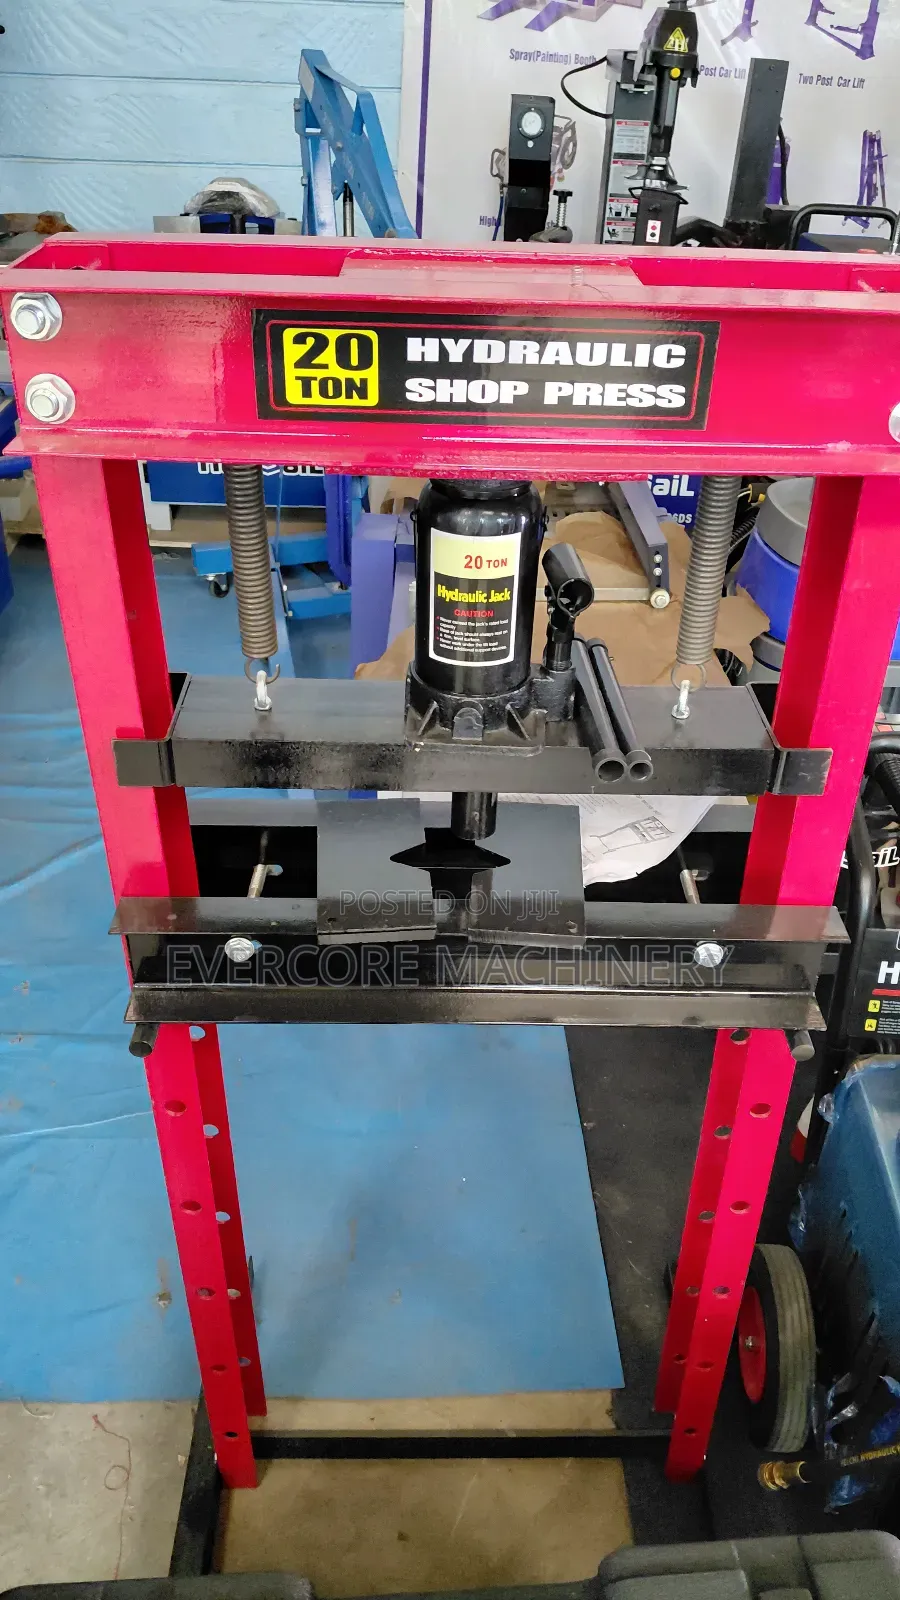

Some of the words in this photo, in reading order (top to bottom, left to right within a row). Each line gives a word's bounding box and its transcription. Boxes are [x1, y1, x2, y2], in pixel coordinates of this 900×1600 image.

[509, 48, 572, 65] Spray(Painting)
[574, 54, 597, 66] Booth
[700, 65, 717, 77] Post
[718, 66, 732, 78] Car
[734, 68, 746, 79] Lift
[799, 73, 814, 85] Two
[815, 75, 832, 86] Post
[837, 76, 851, 88] Car
[852, 78, 865, 89] Lift
[292, 331, 374, 372] 20
[406, 337, 687, 369] HYDRAULIC
[295, 376, 369, 400] TON
[405, 377, 530, 404] SHOP
[544, 381, 686, 408] PRESS
[464, 554, 483, 569] 20
[486, 558, 508, 569] TON
[437, 584, 487, 603] Hydraulic
[489, 588, 511, 602] Jack
[454, 608, 494, 617] CAUTION
